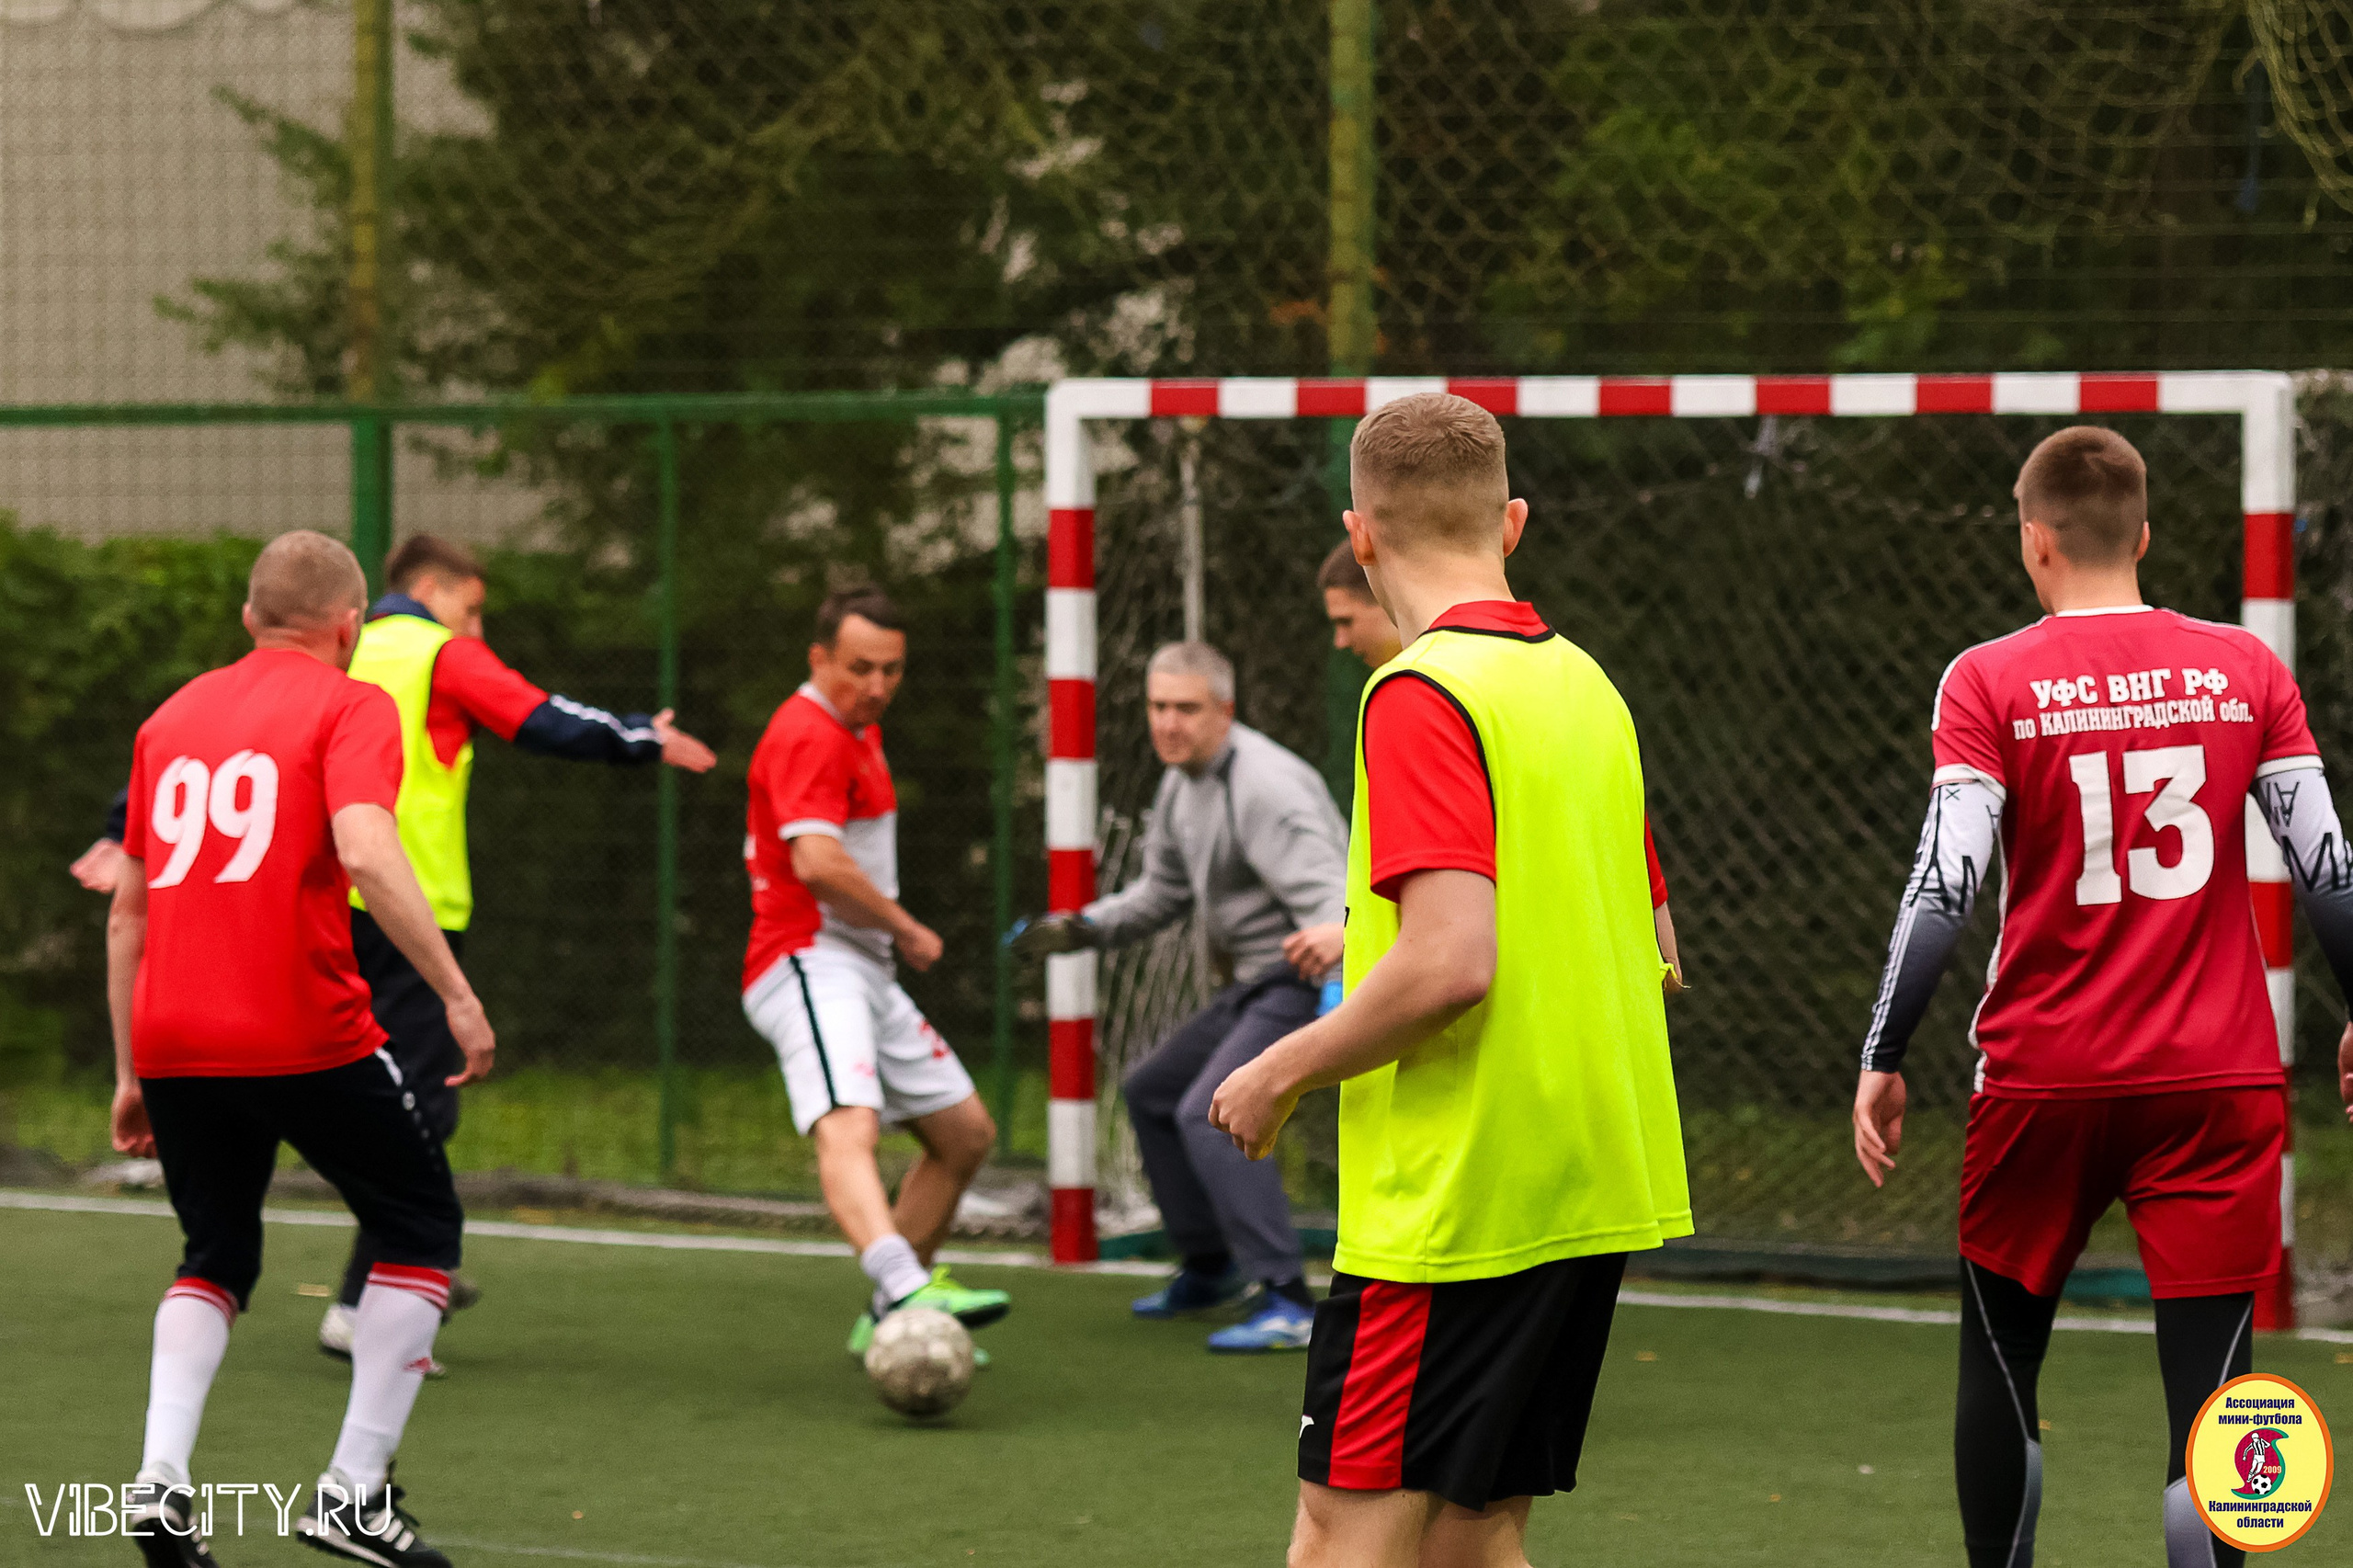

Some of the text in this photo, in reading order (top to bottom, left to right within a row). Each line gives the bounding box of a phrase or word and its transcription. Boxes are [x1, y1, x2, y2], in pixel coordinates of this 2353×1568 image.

[2029, 667, 2228, 710] УФС ВНГ РФ
[2040, 694, 2216, 736] КАЛИНИНГРАДСКОЙ
[147, 748, 279, 890] 99
[2068, 744, 2215, 905] 13
